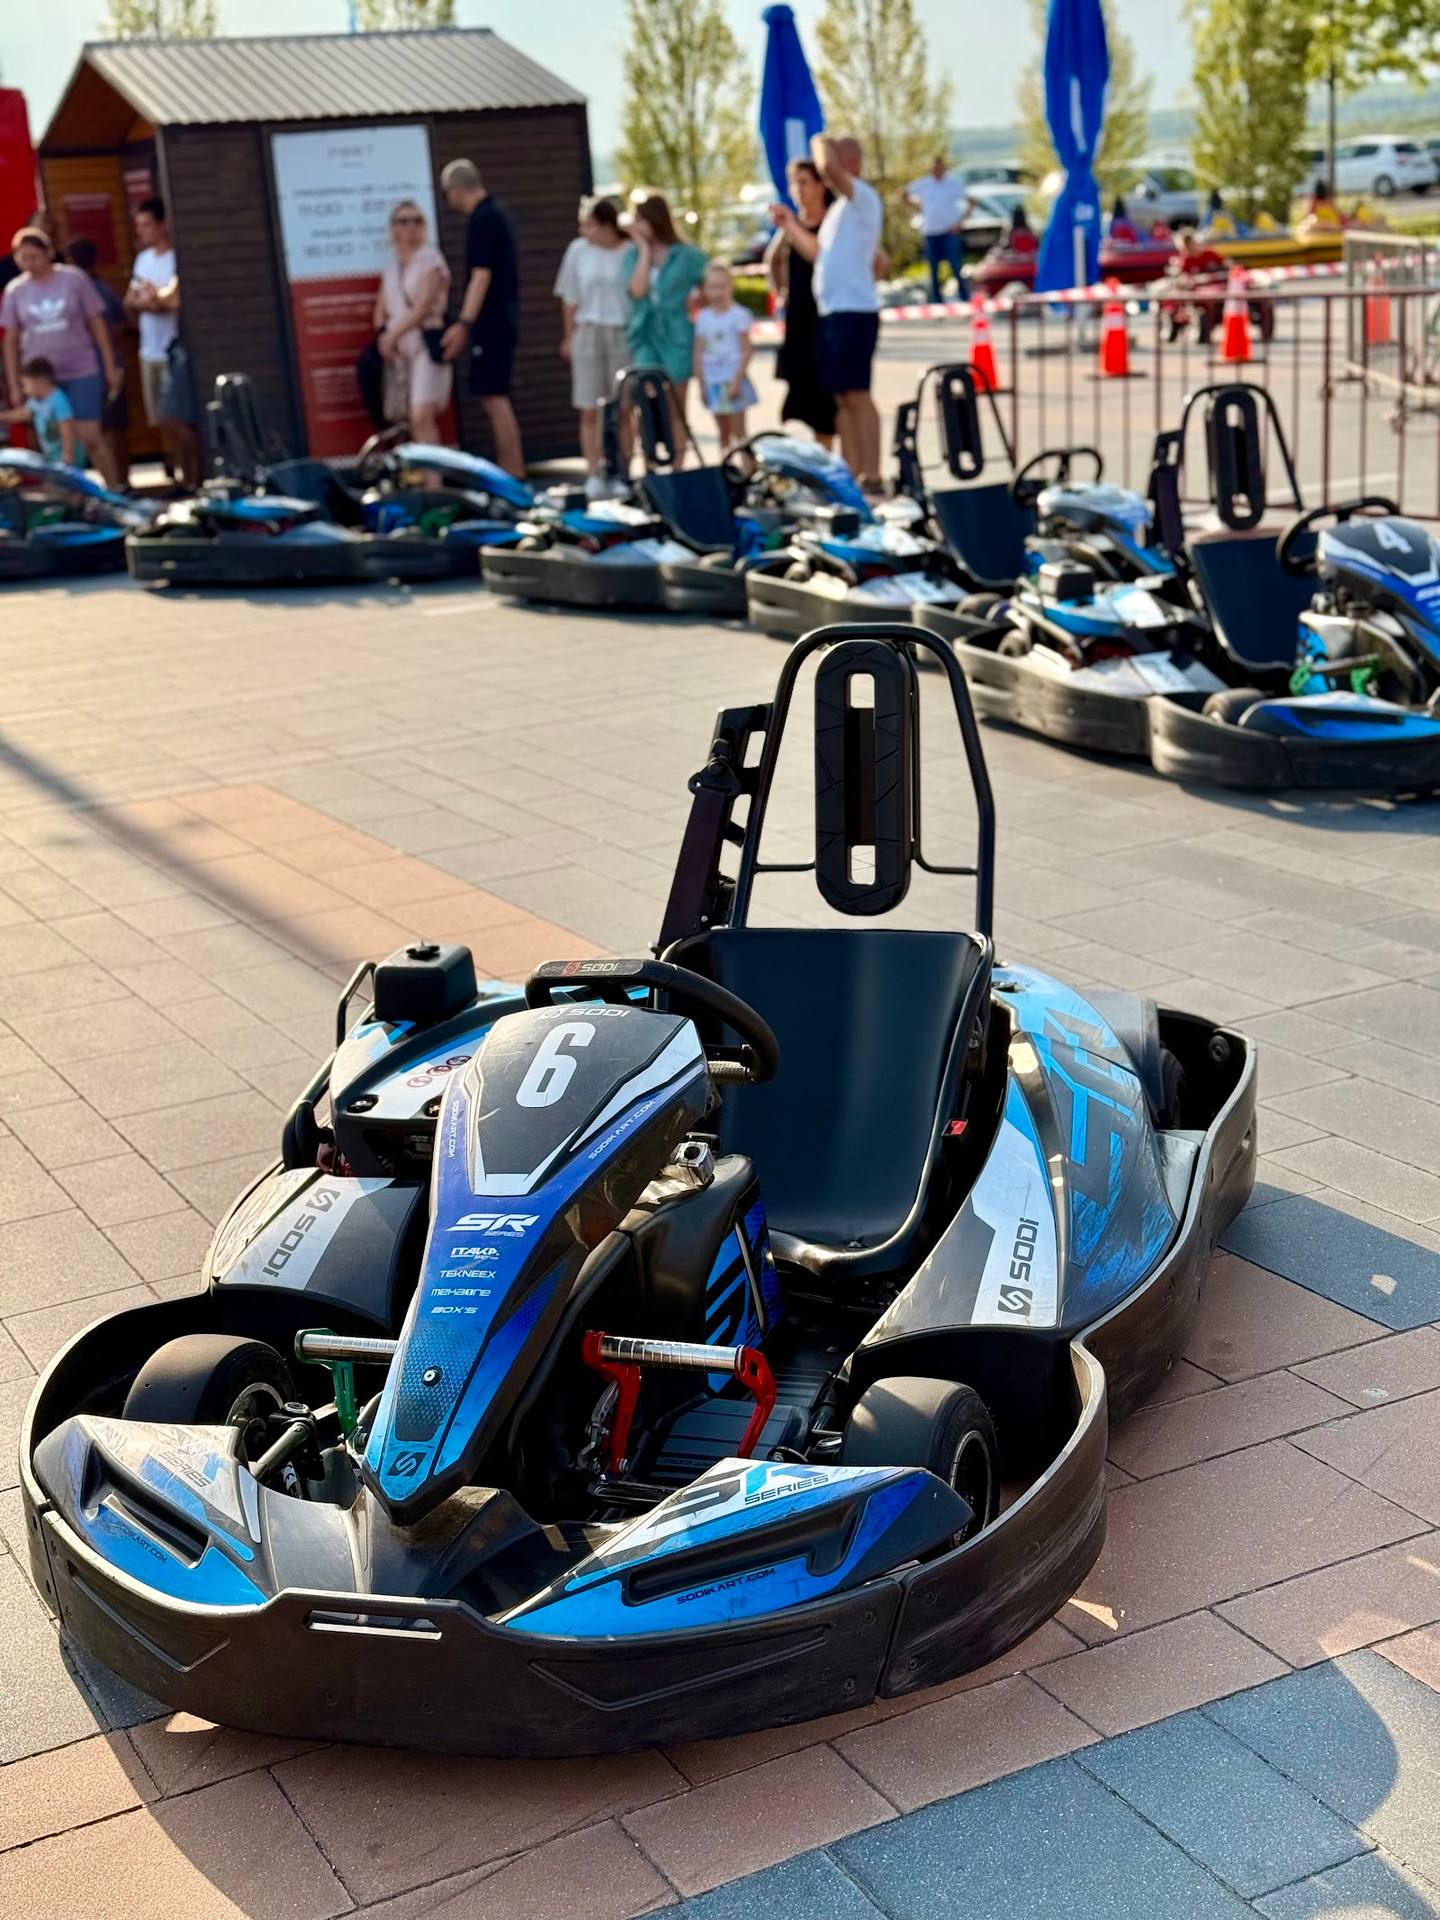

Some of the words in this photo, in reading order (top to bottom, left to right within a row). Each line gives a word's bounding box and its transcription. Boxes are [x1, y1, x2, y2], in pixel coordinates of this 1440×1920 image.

[1374, 523, 1414, 554] 4
[580, 962, 619, 972] SODI
[566, 1008, 631, 1017] SODI
[516, 1022, 596, 1108] 6
[448, 1100, 460, 1158] SODIKART.COM
[588, 1101, 655, 1160] SODIKART.COM
[445, 1213, 541, 1232] SR
[262, 1213, 318, 1278] SODI
[1009, 1217, 1039, 1282] SODI
[440, 1270, 497, 1279] TEKNEEX
[744, 1475, 829, 1506] SERIES
[675, 1567, 777, 1605] SODIKART.COM
